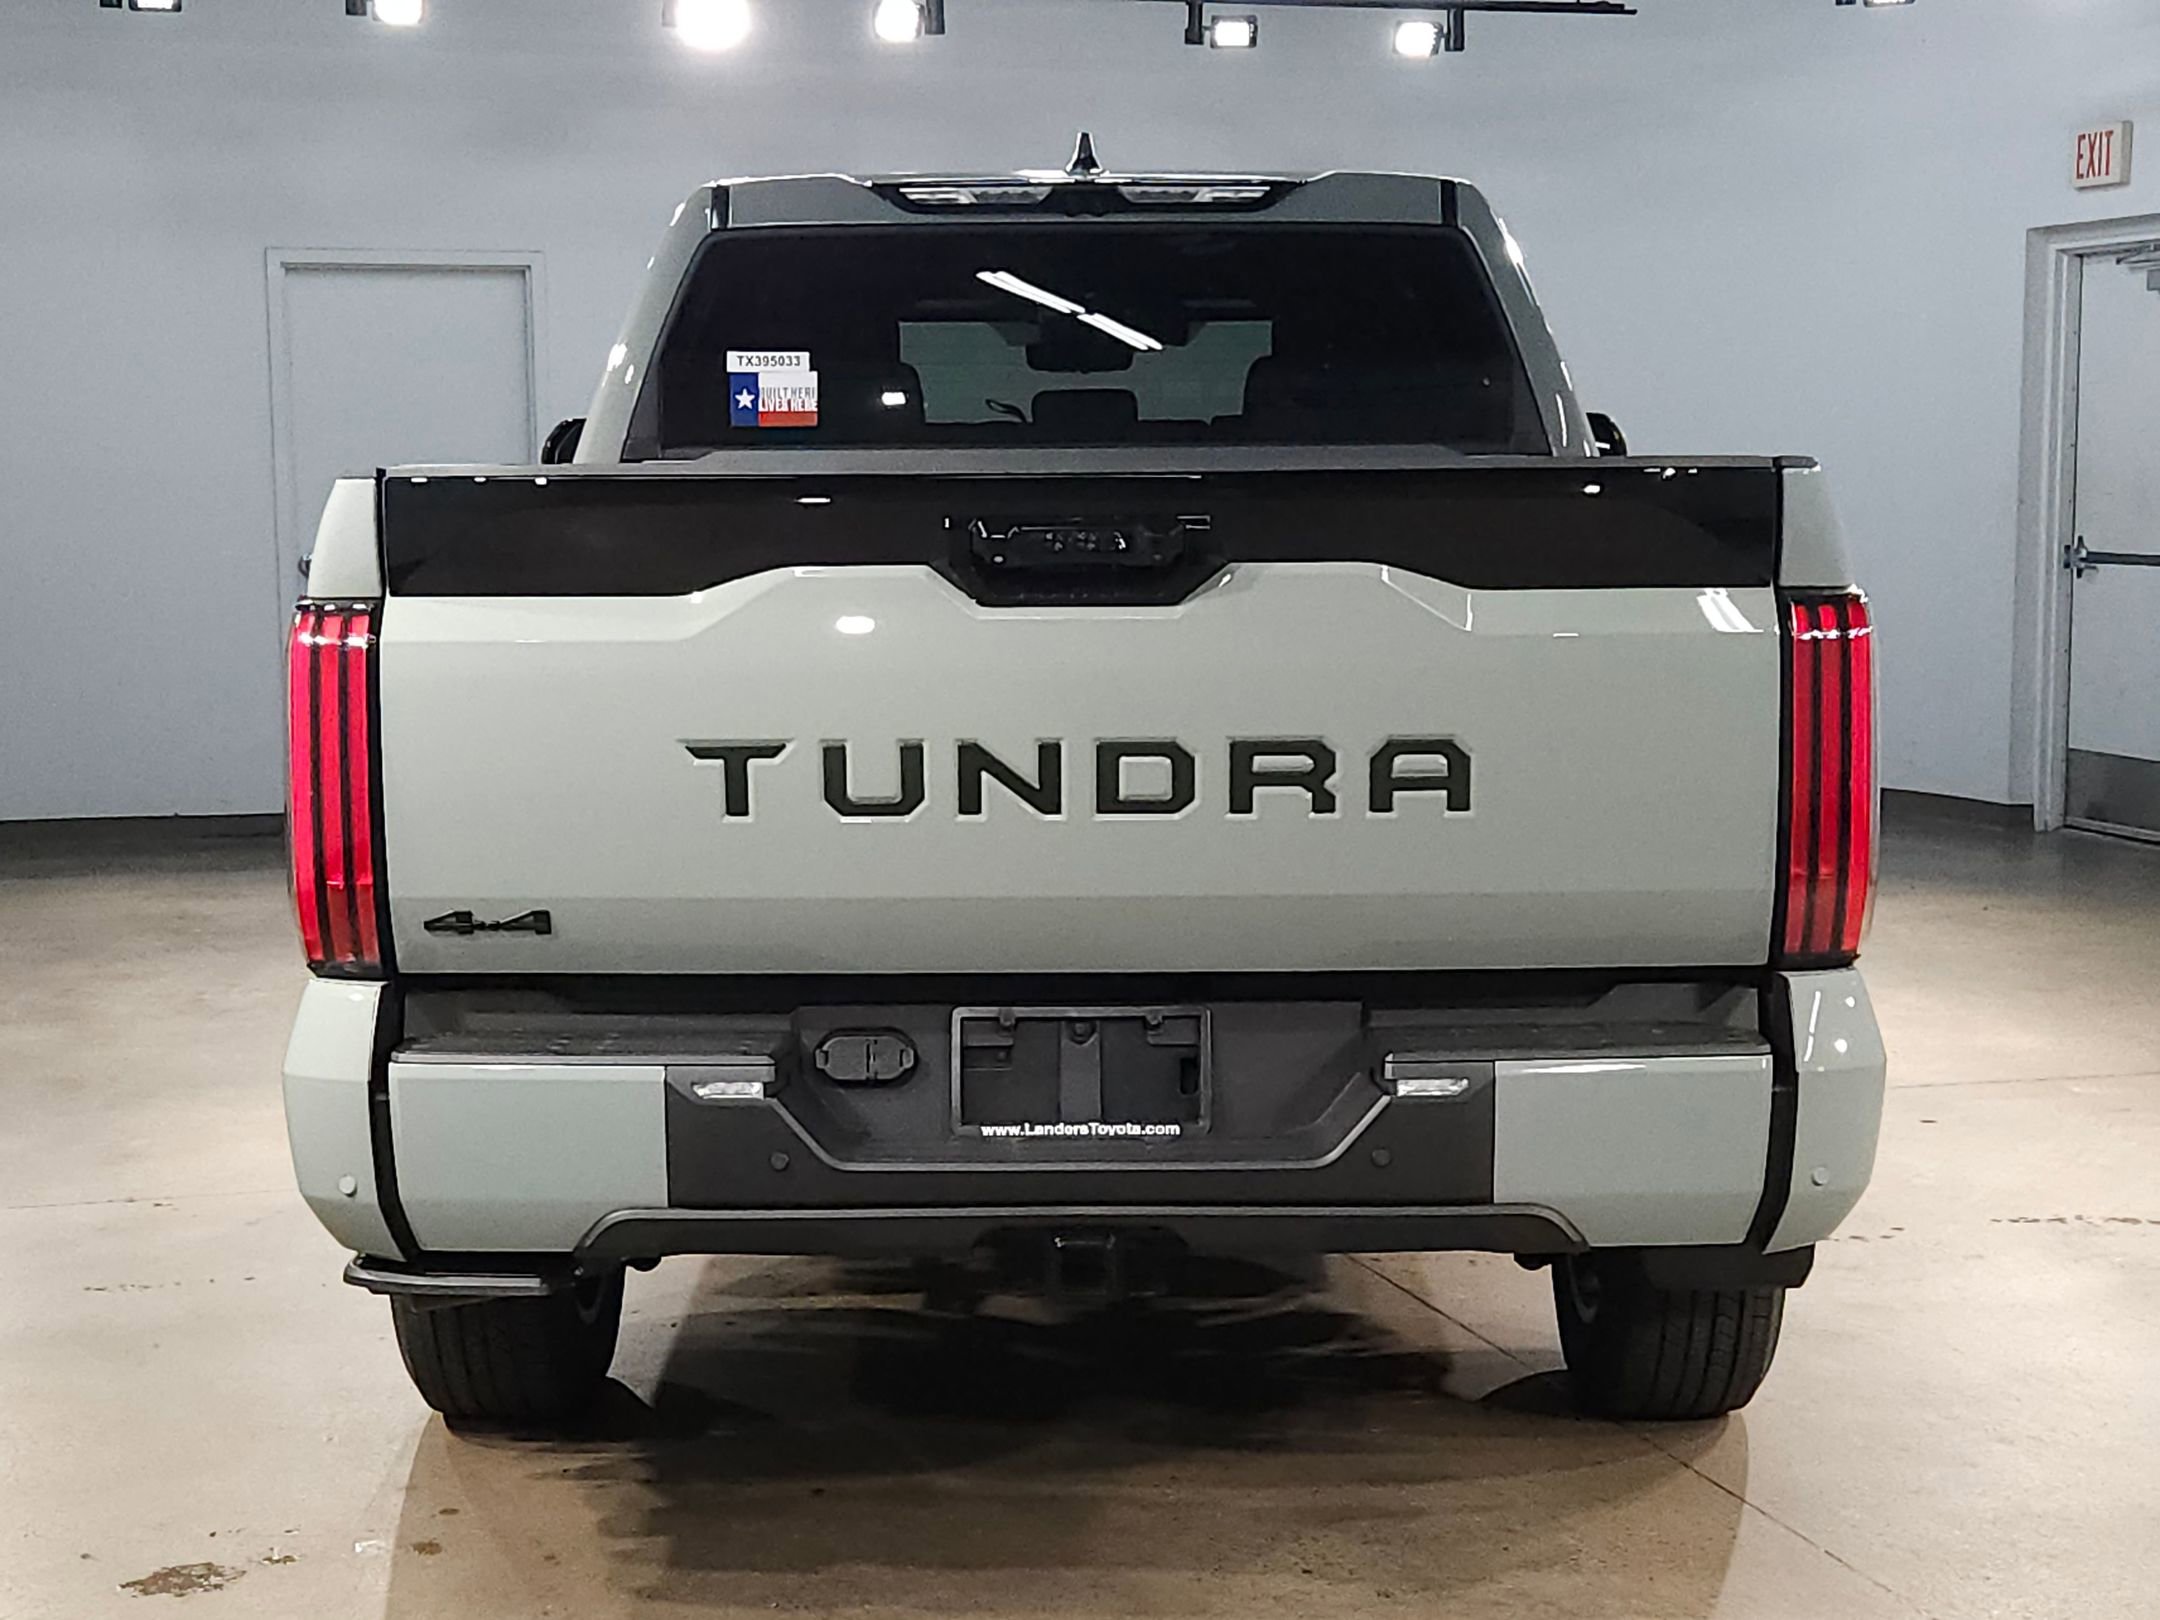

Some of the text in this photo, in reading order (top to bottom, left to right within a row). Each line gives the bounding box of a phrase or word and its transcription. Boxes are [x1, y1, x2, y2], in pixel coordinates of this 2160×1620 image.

[2076, 130, 2114, 179] EXIT
[737, 355, 801, 367] TX395033
[684, 739, 1472, 818] TUNDRA
